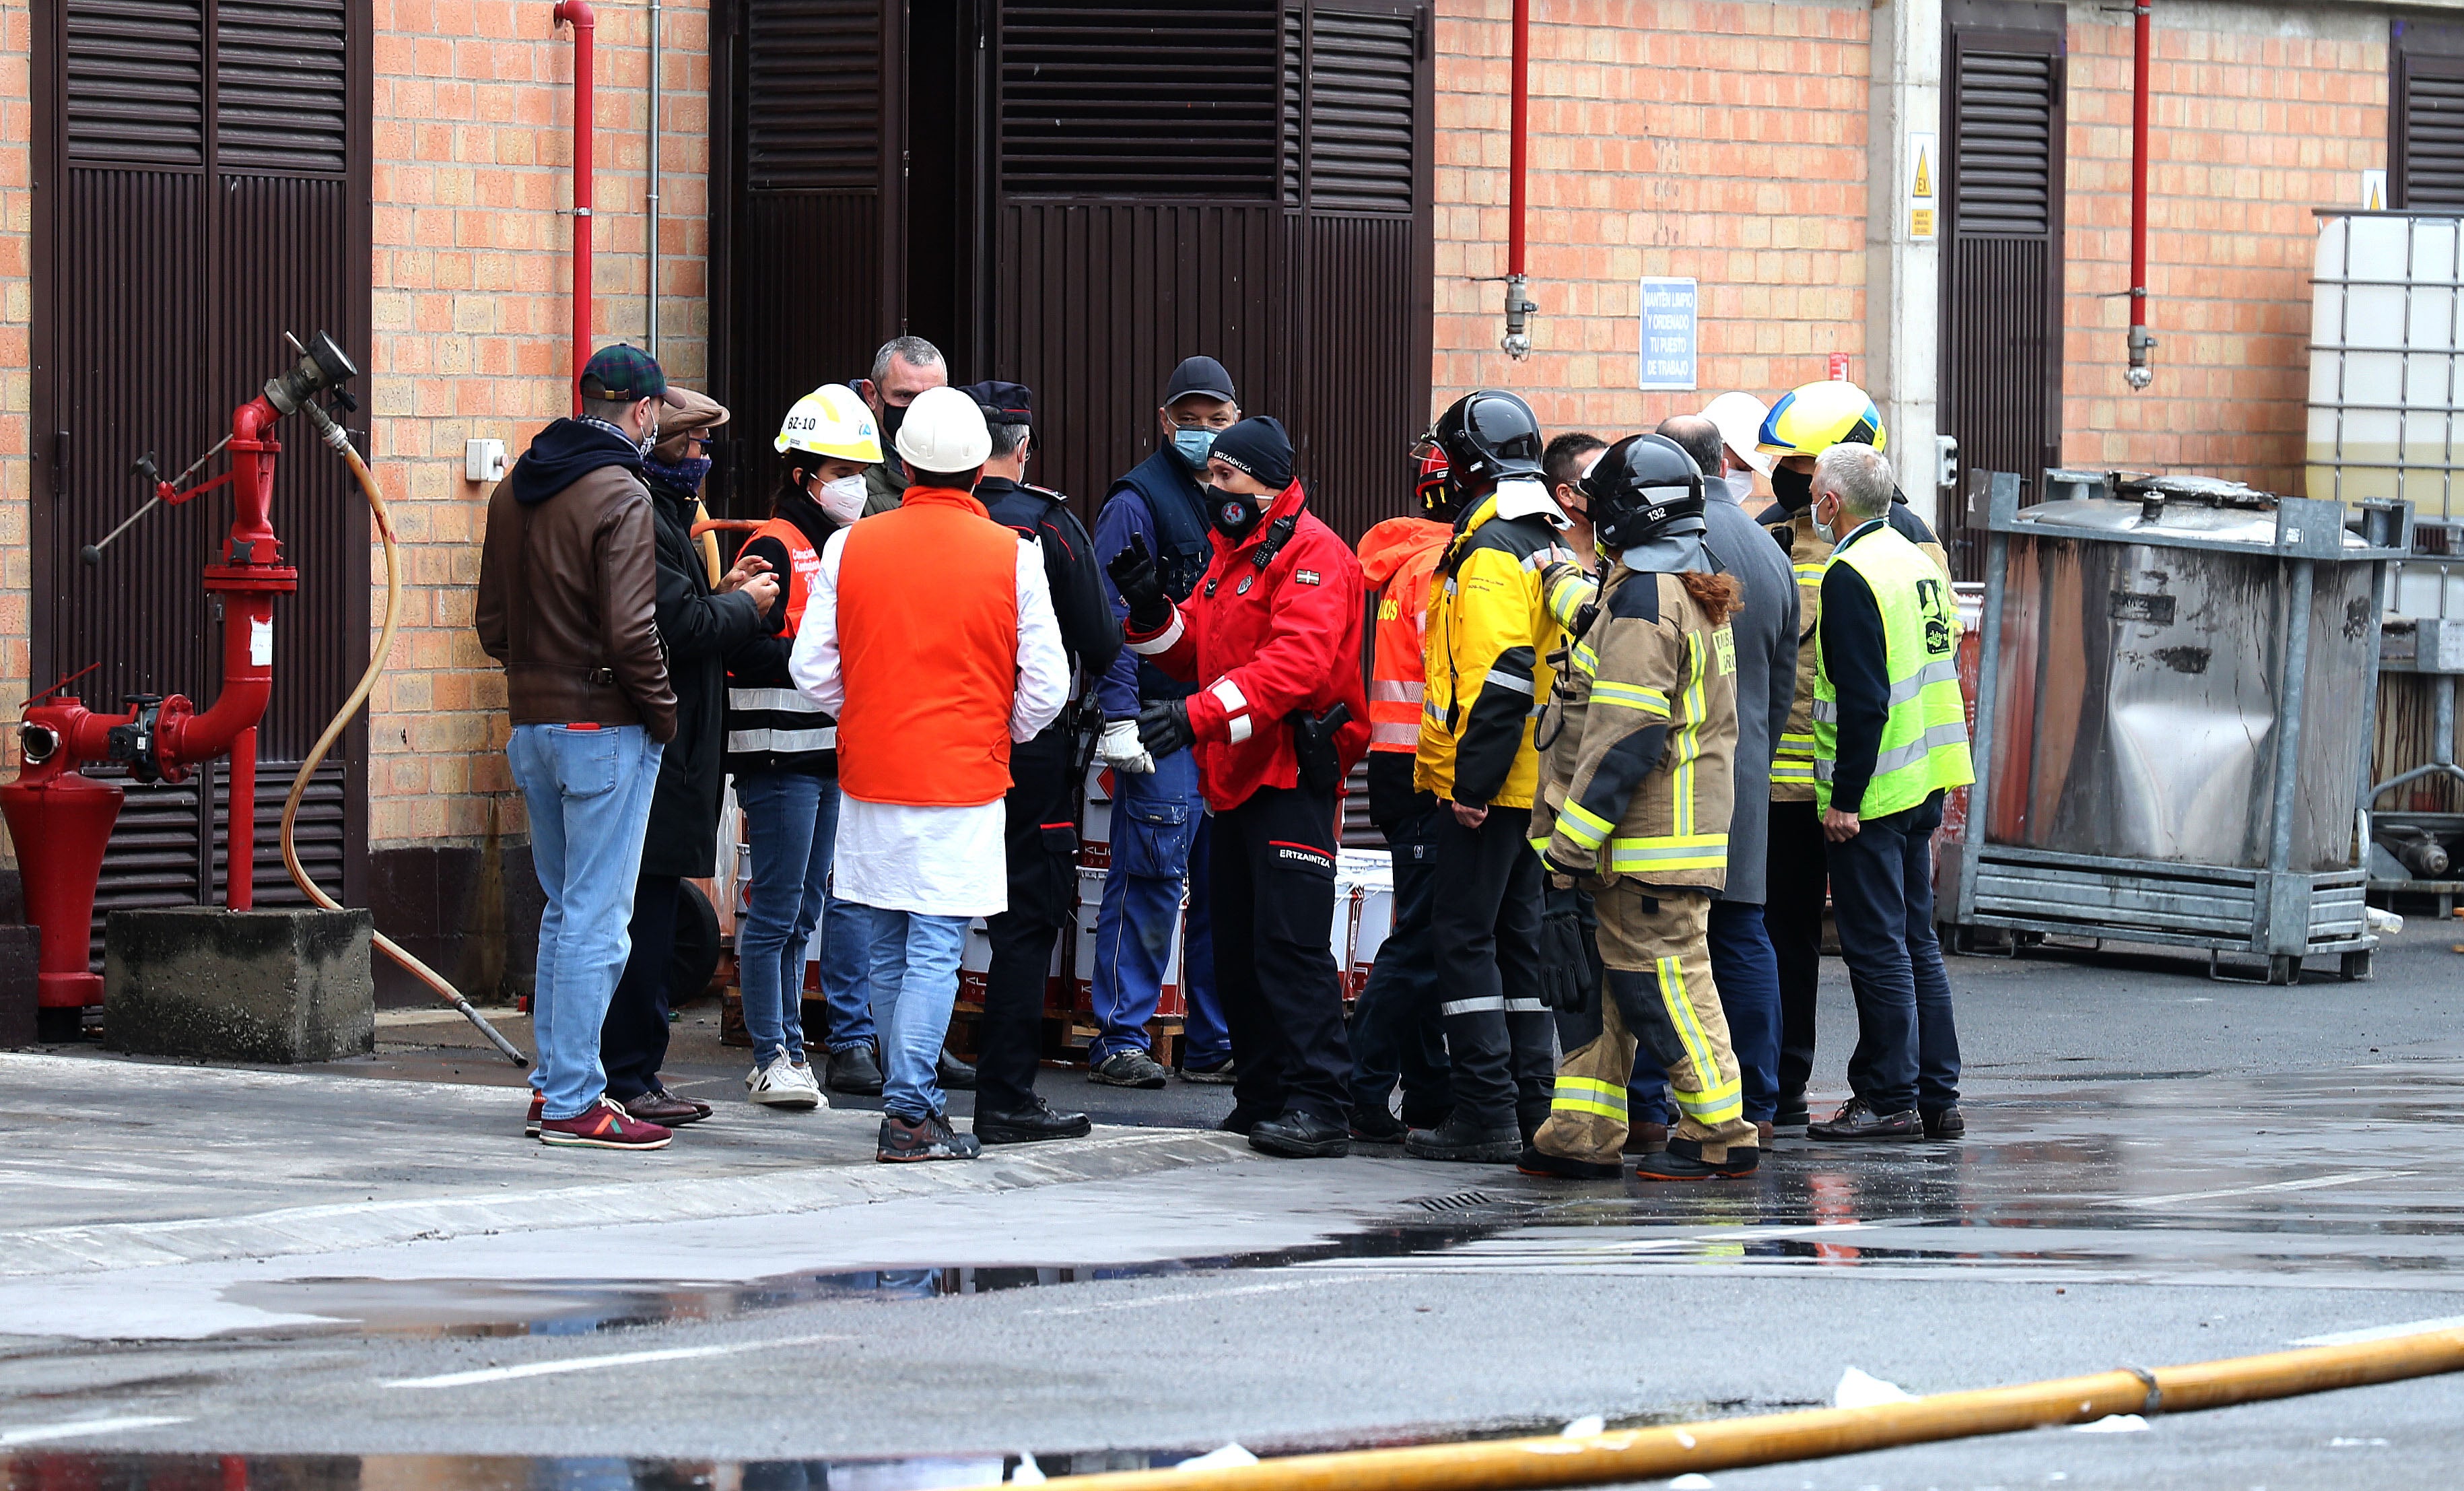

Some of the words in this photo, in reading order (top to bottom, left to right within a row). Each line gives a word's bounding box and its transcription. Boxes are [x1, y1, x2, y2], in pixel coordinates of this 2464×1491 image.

[1918, 177, 1927, 193] EX
[1672, 292, 1693, 308] LIMPIO
[1647, 314, 1653, 329] Y
[1653, 314, 1690, 330] ORDENADO
[1650, 337, 1659, 352] TU
[1660, 336, 1687, 353] PUESTO
[1647, 360, 1657, 376] DE
[1658, 360, 1689, 376] TRABAJO
[788, 417, 816, 430] BZ-10
[1647, 507, 1666, 521] 132
[1280, 849, 1330, 869] ERTZAINTZA
